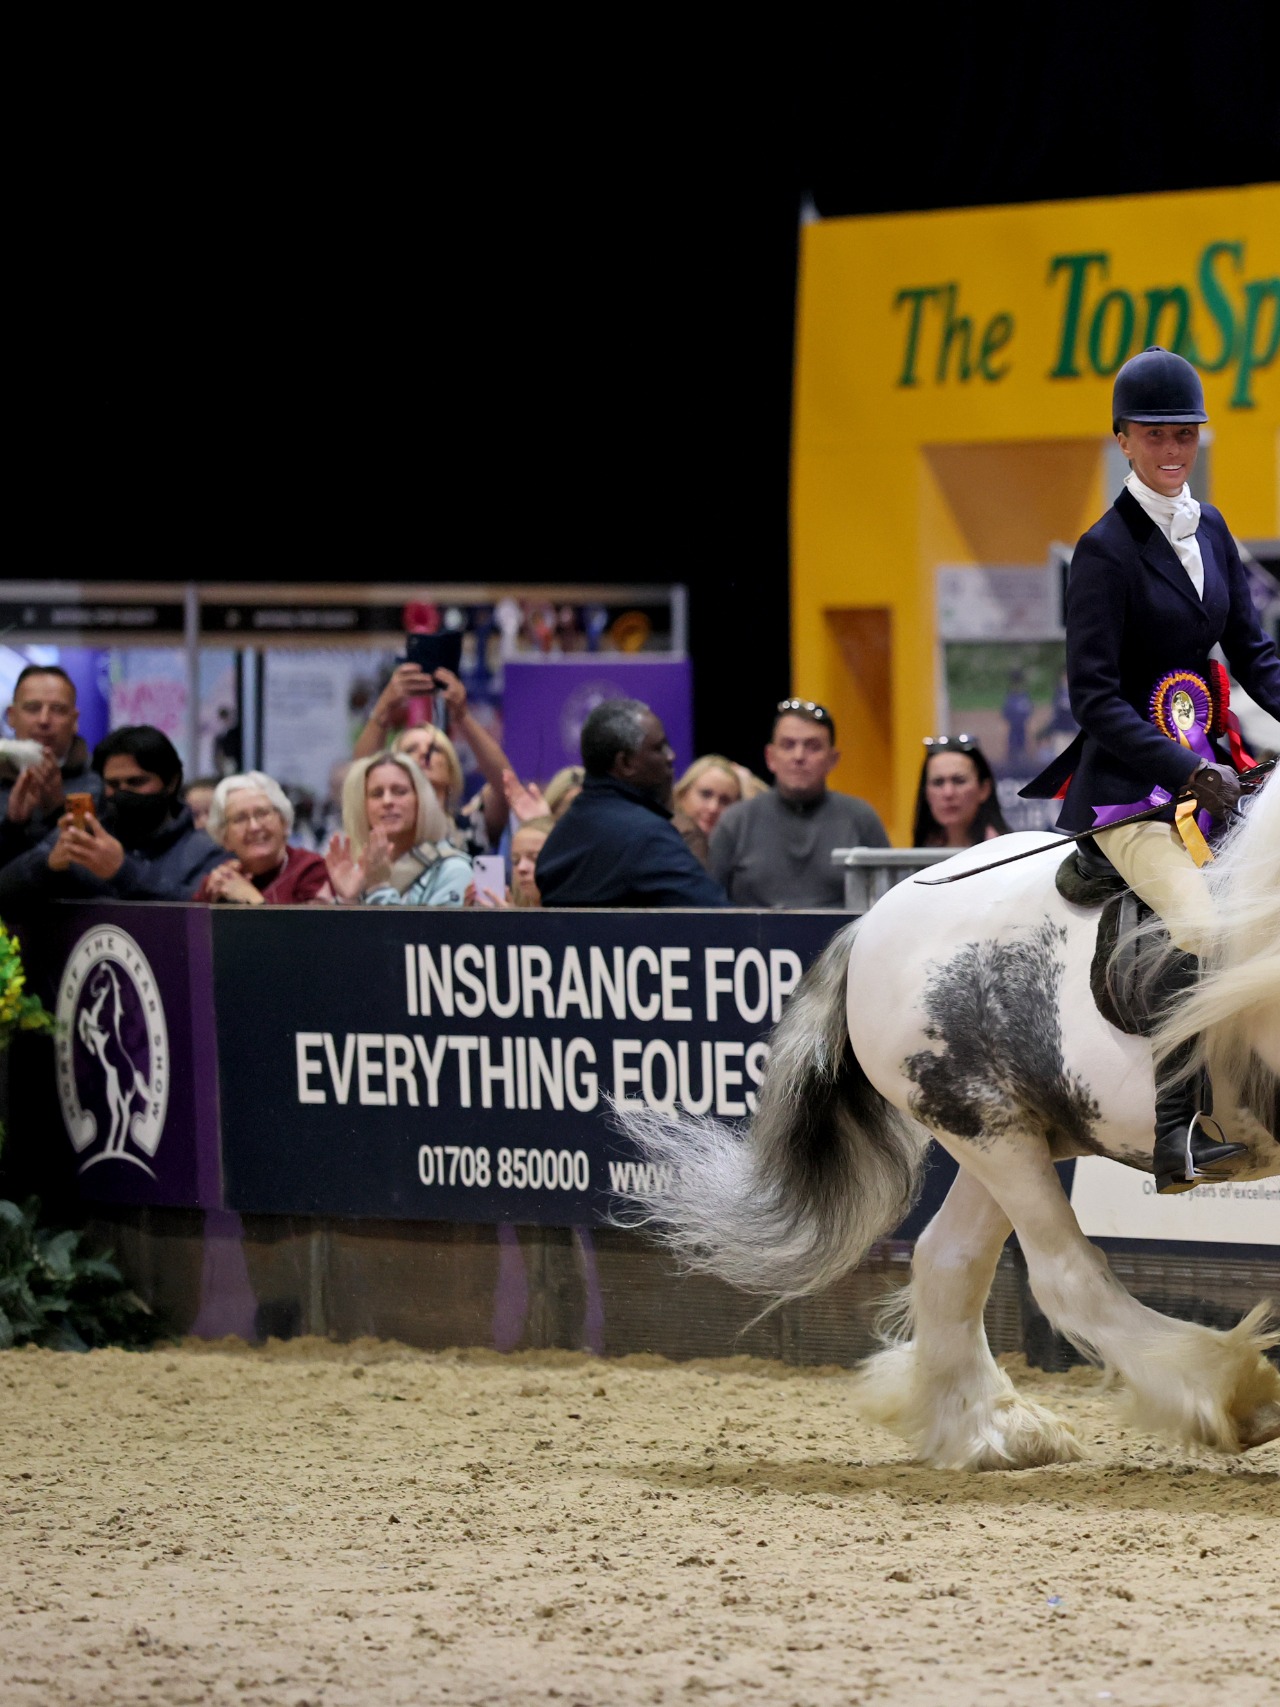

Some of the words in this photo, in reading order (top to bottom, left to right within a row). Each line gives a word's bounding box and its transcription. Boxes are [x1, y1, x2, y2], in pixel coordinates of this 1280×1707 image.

[896, 282, 1014, 389] The
[404, 943, 694, 1023] INSURANCE
[65, 967, 81, 1000] OF
[84, 936, 116, 959] THE
[124, 946, 157, 1013] YEAR
[151, 1033, 164, 1121] SHOW
[295, 1031, 600, 1113] EVERYTHING
[418, 1144, 491, 1187] 01708
[497, 1146, 590, 1191] 850000
[1219, 1182, 1233, 1200] of
